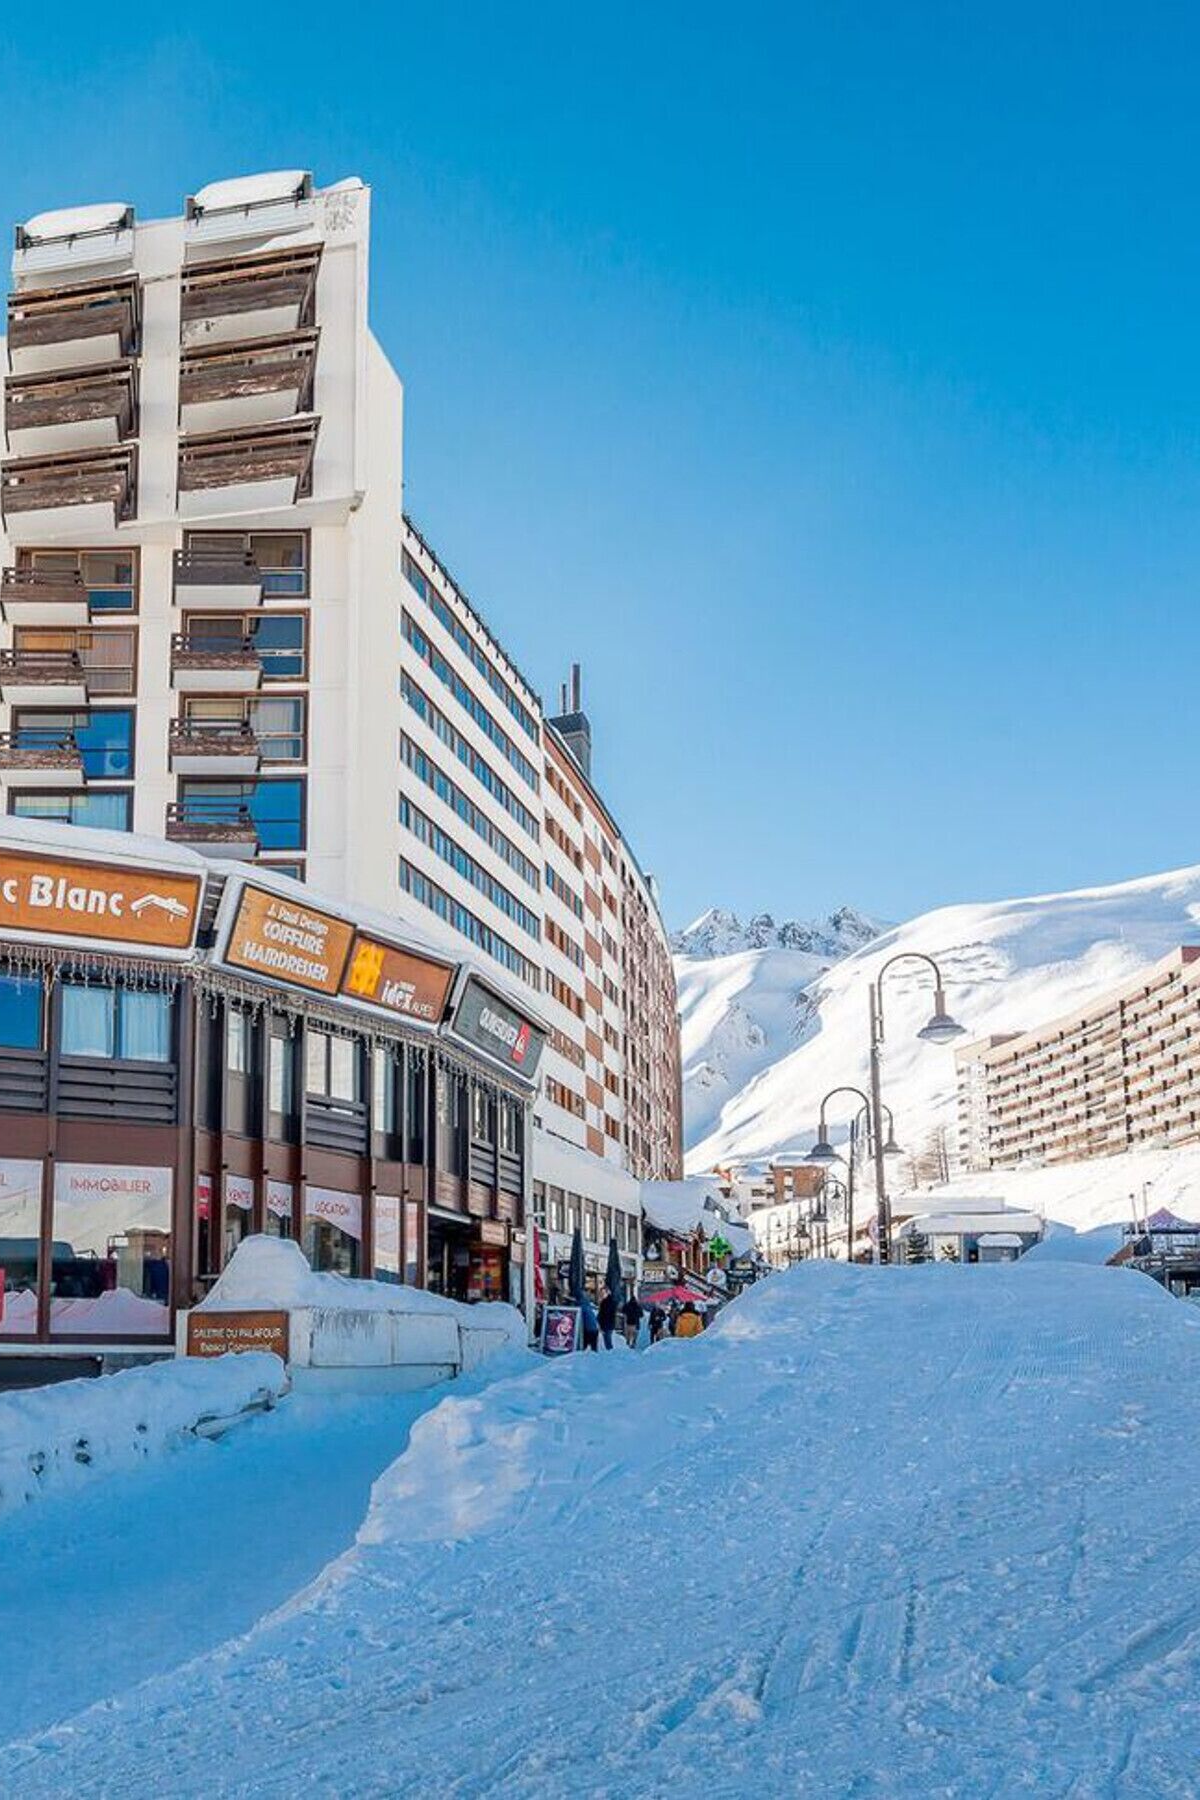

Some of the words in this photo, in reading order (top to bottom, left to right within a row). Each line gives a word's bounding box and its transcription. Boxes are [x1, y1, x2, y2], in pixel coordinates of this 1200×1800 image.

[29, 875, 124, 917] Blanc
[263, 920, 324, 956] COIFFURE
[244, 940, 329, 982] HAIRDRESSER
[70, 1176, 151, 1193] IMMOBILIER
